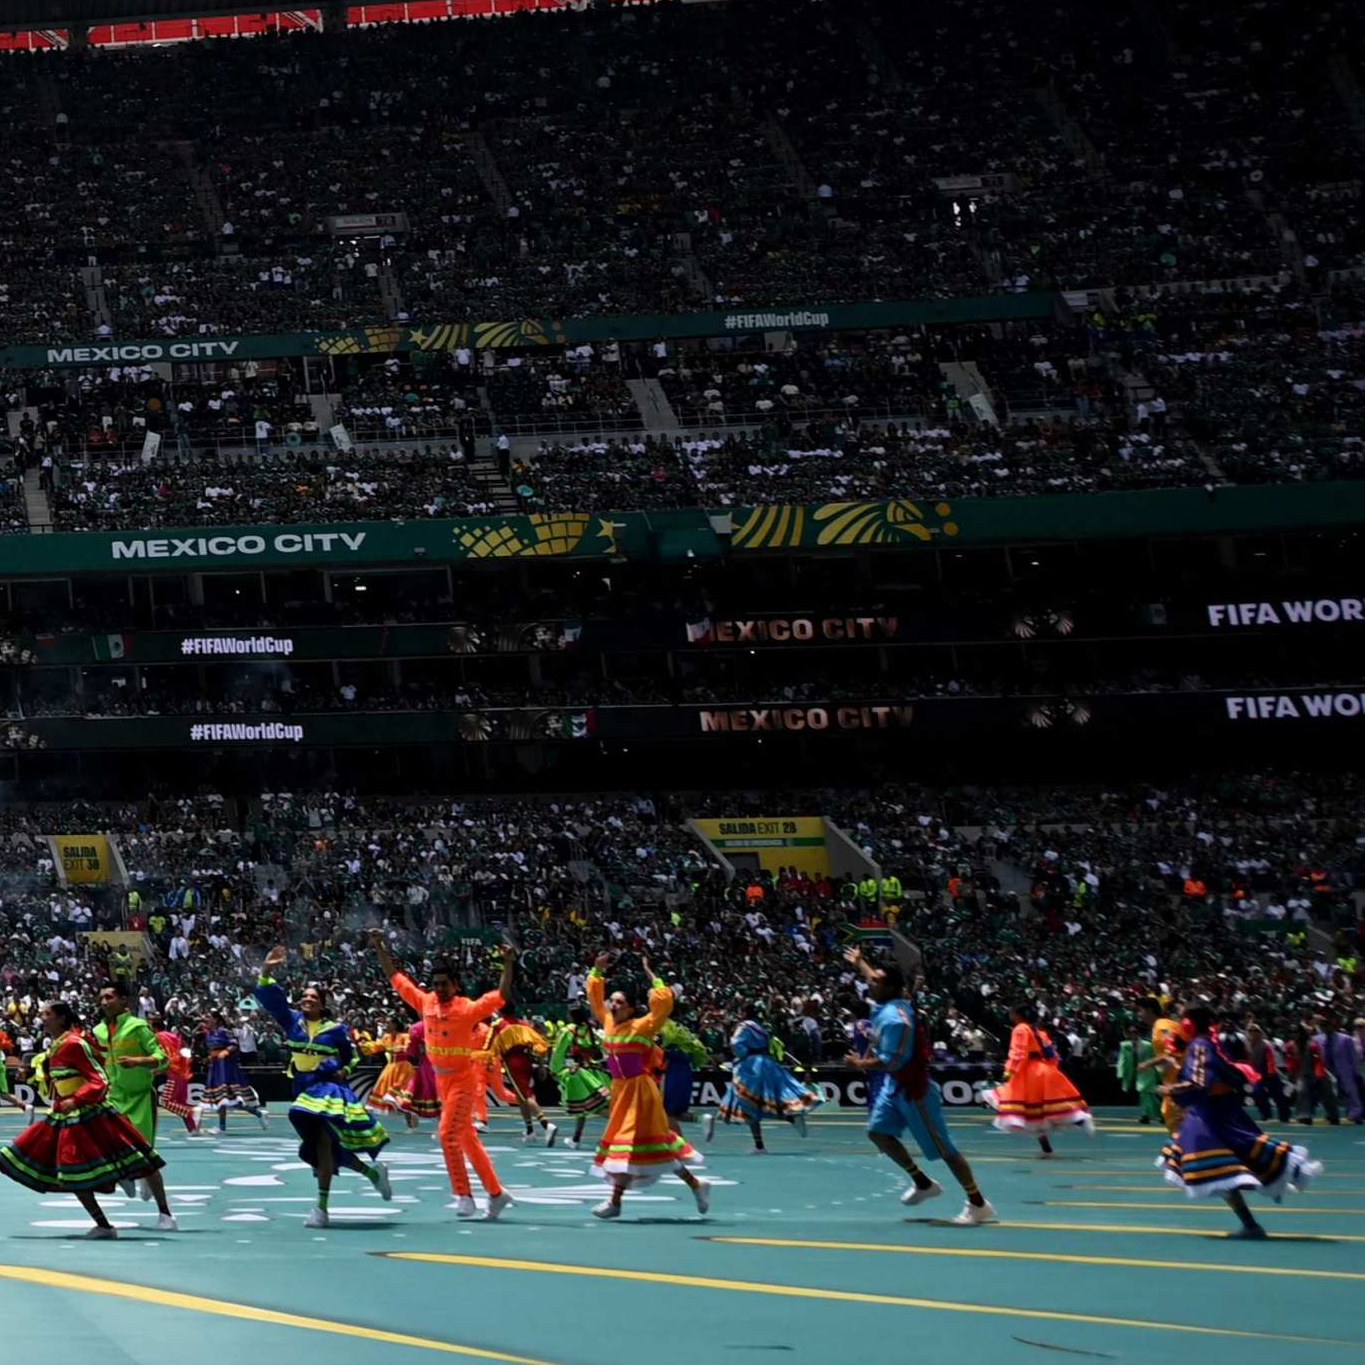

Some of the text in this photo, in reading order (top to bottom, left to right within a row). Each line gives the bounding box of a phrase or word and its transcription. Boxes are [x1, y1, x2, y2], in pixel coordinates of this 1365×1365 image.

[724, 312, 829, 329] #FIFAWorldCup
[47, 341, 239, 363] MEXICO CITY
[111, 532, 367, 559] MEXICO CITY
[1207, 598, 1365, 627] FIFA WOR
[822, 617, 901, 640] CITY
[181, 636, 293, 655] #FIFAWorldCup
[1226, 693, 1365, 719] FIFA WO
[699, 706, 916, 732] MEXICO CITY
[190, 723, 303, 742] #FIFAWorldCup
[718, 823, 756, 834] SALIDA
[757, 822, 780, 834] EXIT
[63, 846, 97, 858] SALIDA
[63, 859, 84, 870] EXIT
